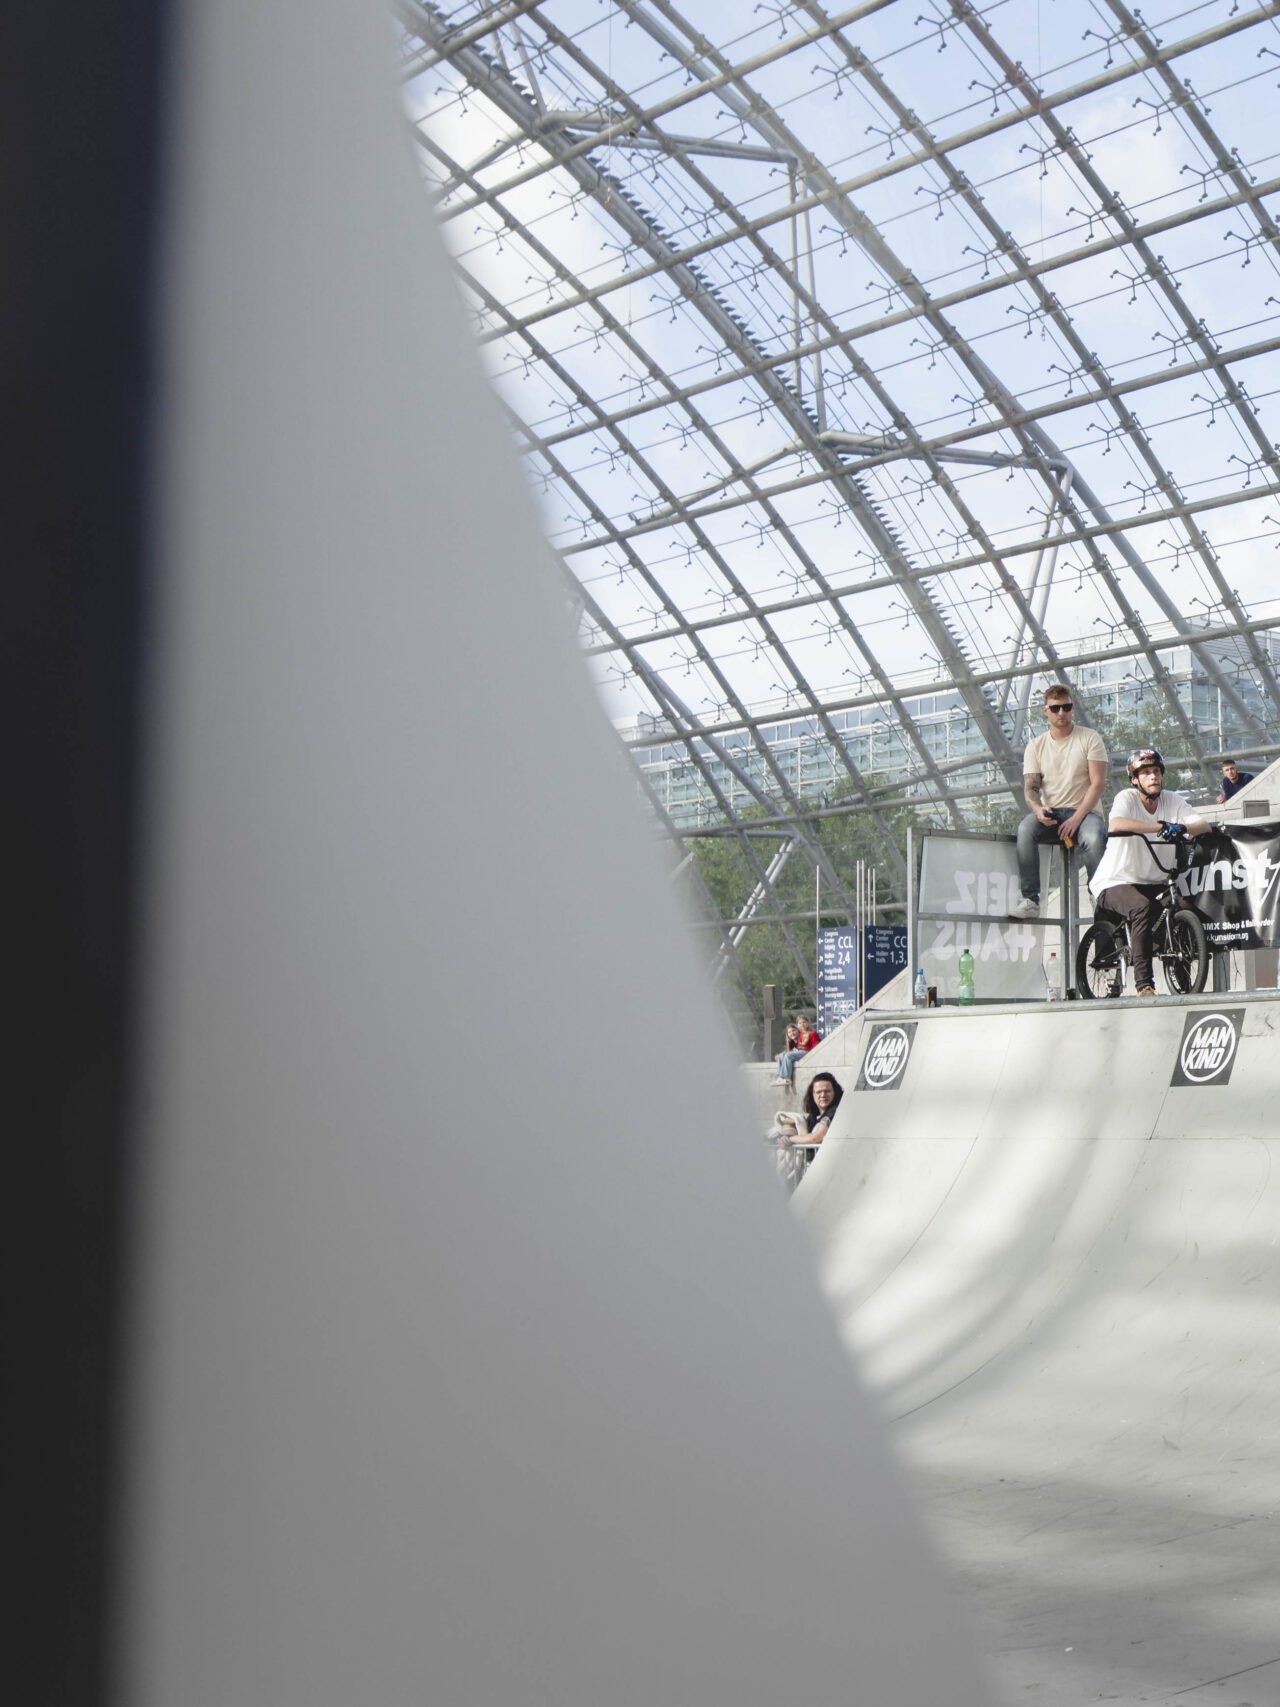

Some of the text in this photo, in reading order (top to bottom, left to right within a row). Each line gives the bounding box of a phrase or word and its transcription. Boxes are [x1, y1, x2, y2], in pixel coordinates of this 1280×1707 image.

[1222, 921, 1240, 931] Shop
[838, 936, 853, 949] CCL
[838, 951, 851, 966] 2,4
[1191, 1023, 1233, 1048] MAN
[873, 1036, 907, 1057] MAN
[867, 1057, 900, 1076] KIND
[1184, 1047, 1226, 1071] KIND
